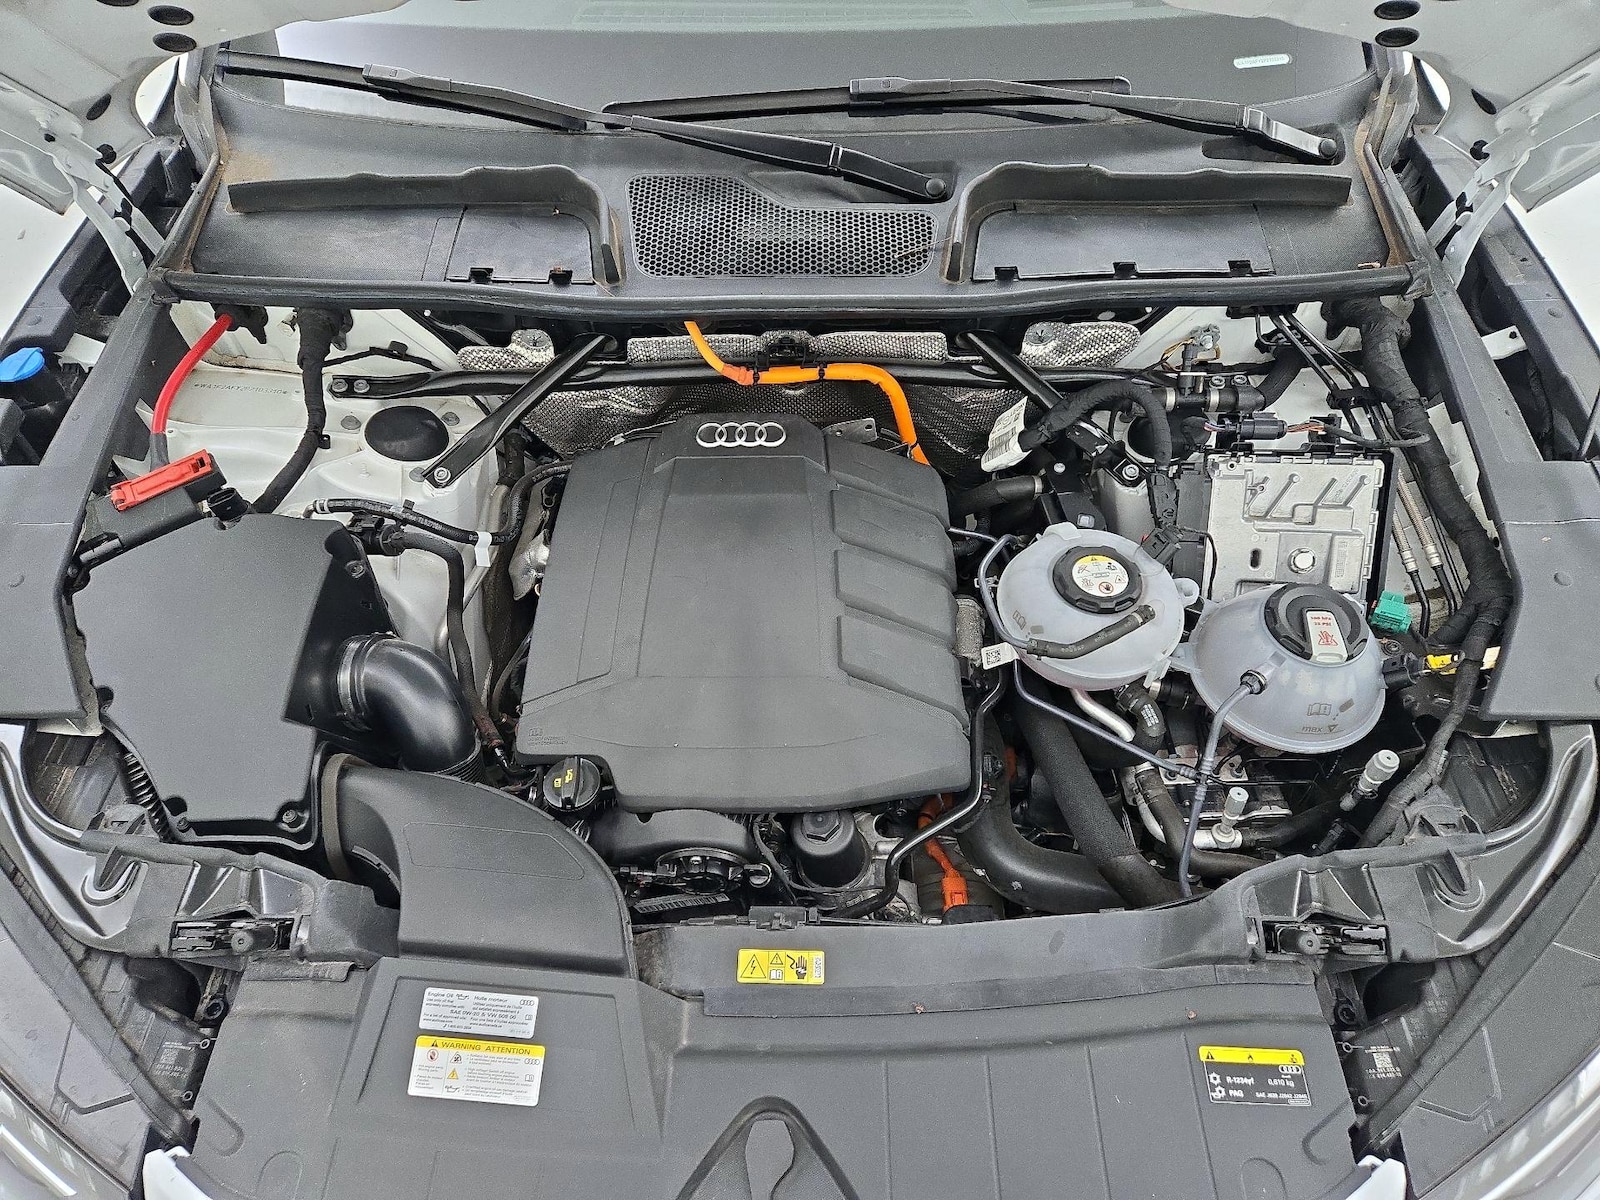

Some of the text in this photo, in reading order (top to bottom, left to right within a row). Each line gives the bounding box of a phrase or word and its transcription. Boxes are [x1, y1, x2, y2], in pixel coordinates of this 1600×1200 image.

[441, 1041, 530, 1055] WARNING ATTENTION
[1226, 1077, 1255, 1086] R-1234yf
[1286, 1079, 1295, 1088] kg
[1229, 1089, 1244, 1098] PAG
